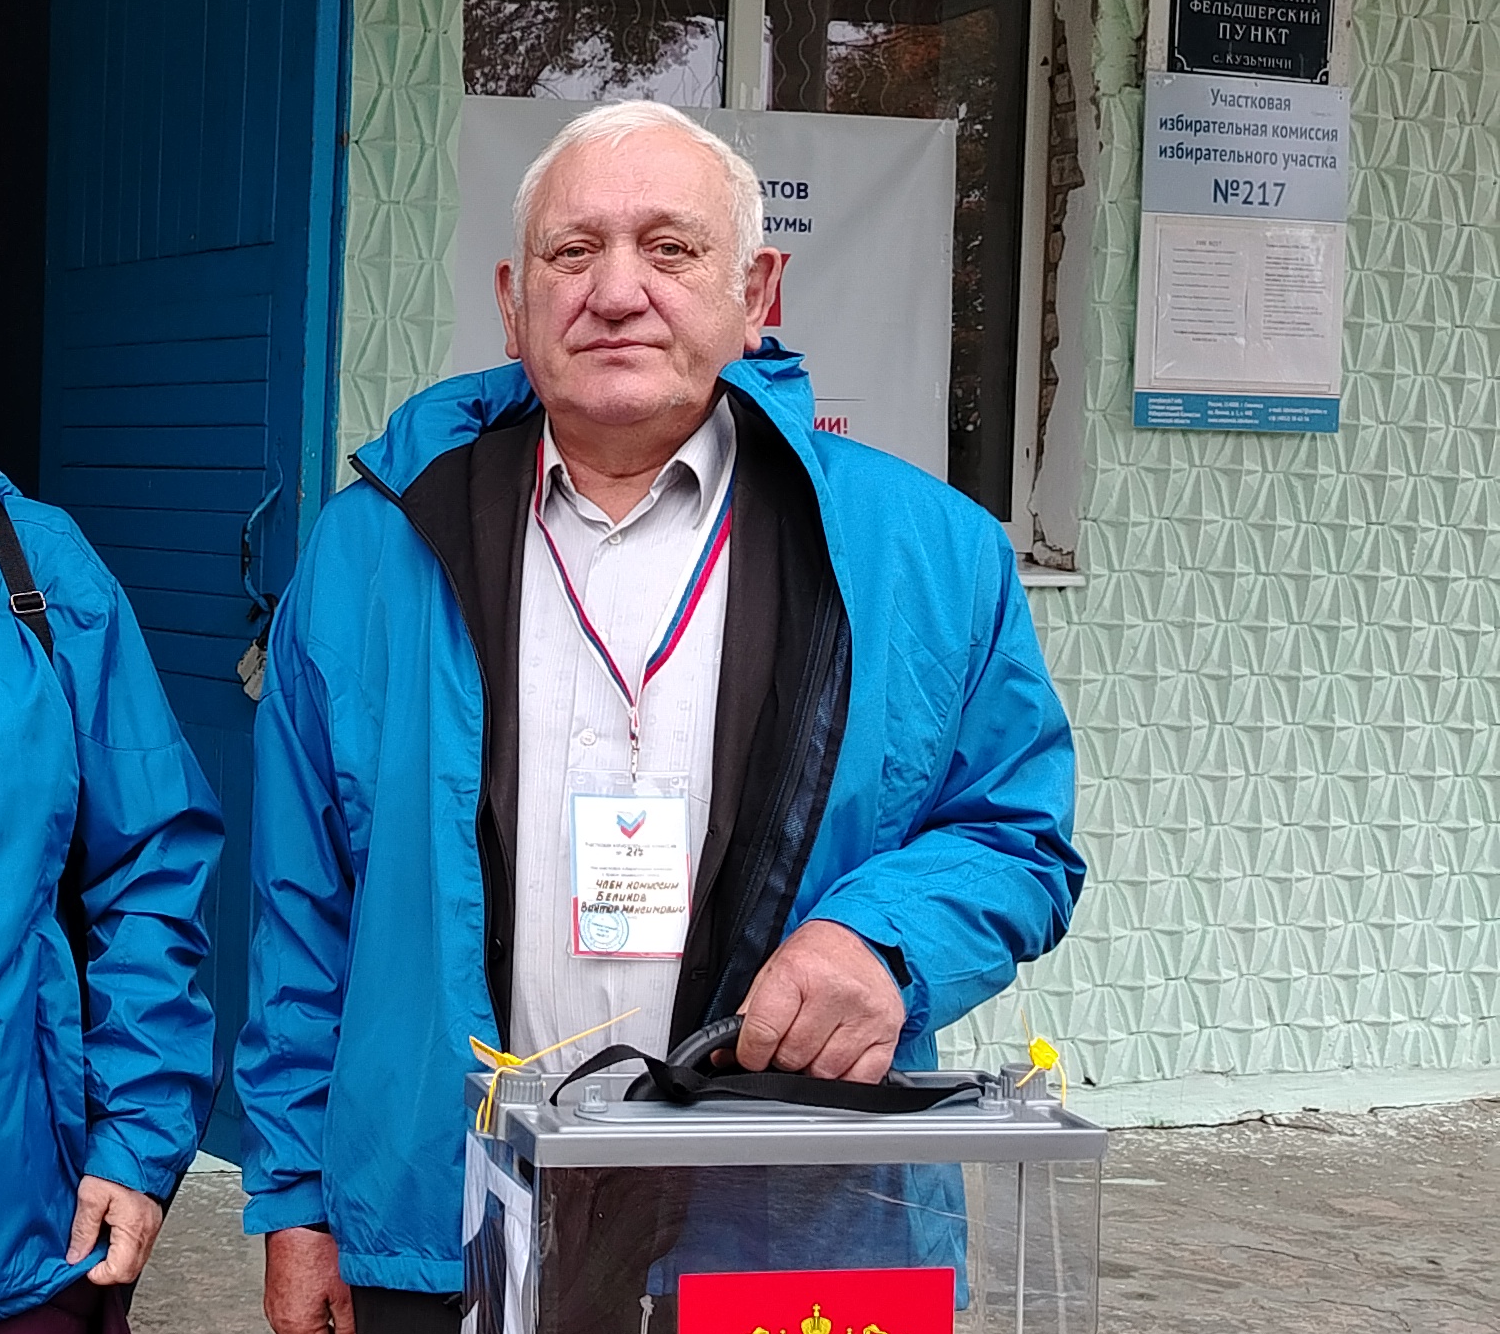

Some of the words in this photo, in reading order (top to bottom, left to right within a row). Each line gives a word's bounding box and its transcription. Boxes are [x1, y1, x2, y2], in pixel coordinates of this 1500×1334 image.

[1189, 0, 1321, 25] ФЕЛЬДШЕРСКИЙ
[1219, 22, 1289, 45] ПУНКТ
[1225, 53, 1292, 70] КУЗЬМИЧИ
[1210, 88, 1291, 111] Участковая
[1159, 114, 1268, 138] избирательная
[1272, 124, 1338, 142] комиссия
[1158, 142, 1278, 165] избирательного
[1282, 152, 1337, 171] участка
[1212, 178, 1287, 207] №217
